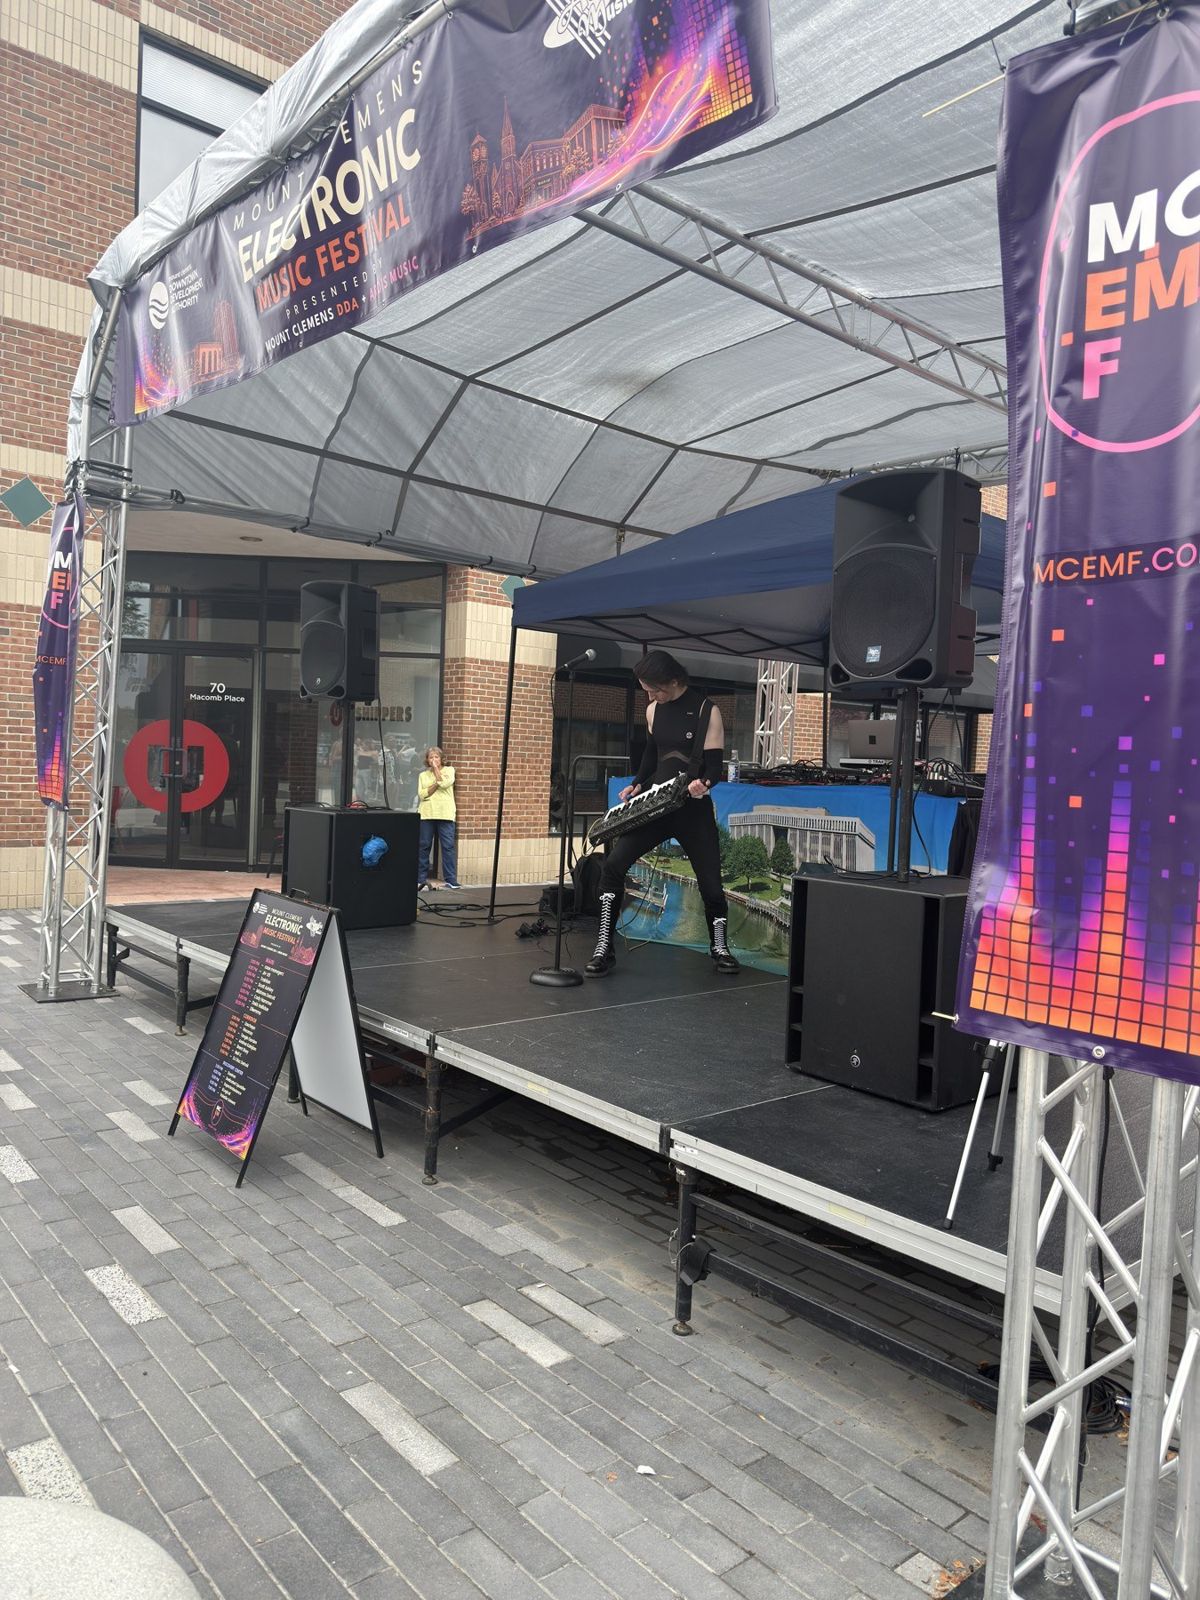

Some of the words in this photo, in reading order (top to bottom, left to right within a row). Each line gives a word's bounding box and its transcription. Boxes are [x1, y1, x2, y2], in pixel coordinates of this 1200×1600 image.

[233, 171, 306, 232] MOUNT
[239, 108, 421, 283] ELECTRONIC
[256, 255, 312, 313] MUSIC
[316, 193, 411, 278] FESTIVAL
[265, 328, 291, 353] MOUNT
[292, 307, 335, 337] CLEMENS
[336, 297, 360, 316] DDA
[389, 255, 419, 285] MUSIC
[285, 271, 368, 319] PRESENTED
[1085, 241, 1200, 332] EM
[1082, 337, 1122, 400] F
[1034, 542, 1200, 585] MCEMF.CO
[51, 591, 64, 610] F
[190, 693, 222, 702] Macomb
[224, 694, 245, 702] Place
[210, 682, 226, 694] 70
[262, 926, 277, 938] MUSIC
[276, 932, 297, 945] FESTIVAL
[264, 914, 304, 935] ELECTRONIC
